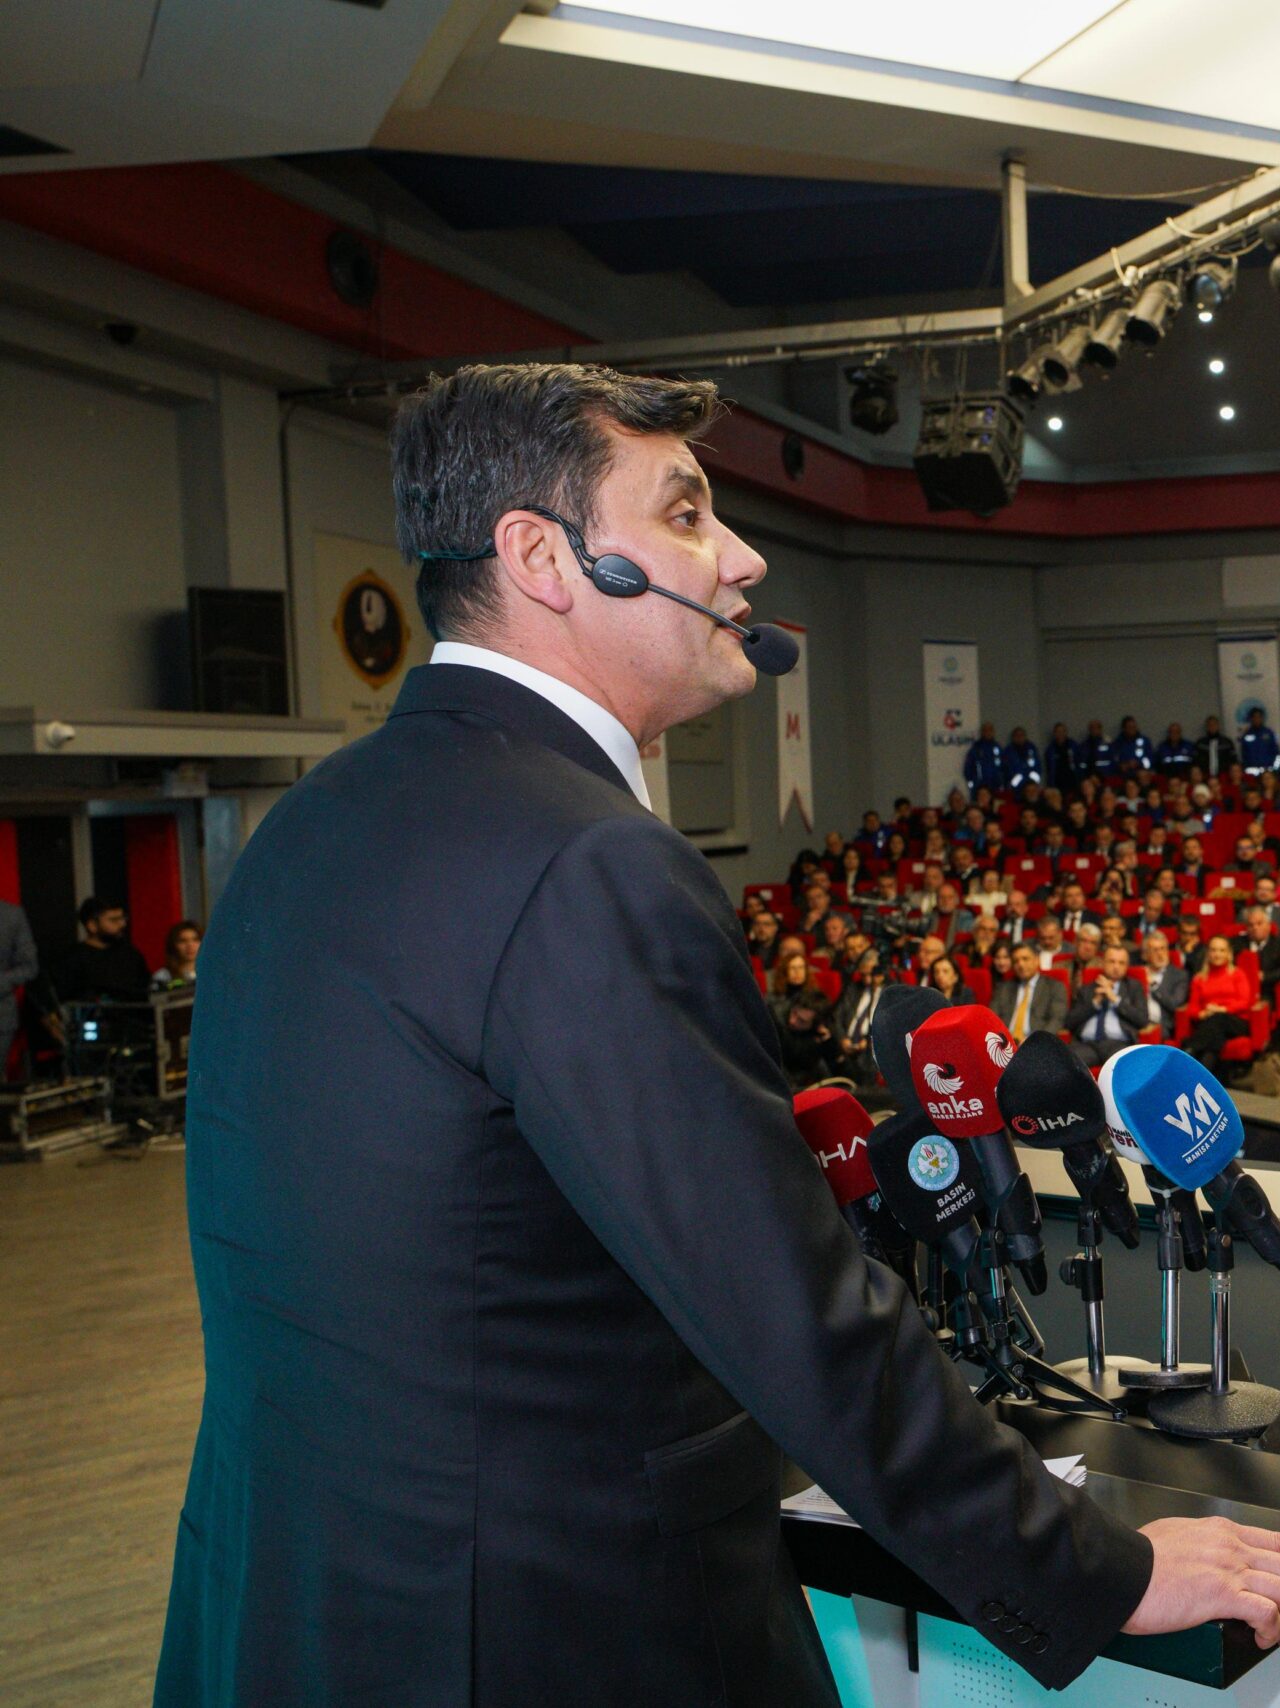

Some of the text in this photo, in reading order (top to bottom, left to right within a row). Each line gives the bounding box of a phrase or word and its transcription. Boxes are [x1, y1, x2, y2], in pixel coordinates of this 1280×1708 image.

[927, 1095, 984, 1115] anka
[1037, 1111, 1085, 1131] İHA
[816, 1135, 867, 1169] HA
[1185, 1116, 1229, 1165] MANİSA MEYDAN
[935, 1188, 976, 1222] MERKEZİ
[936, 1182, 967, 1208] BASIN
